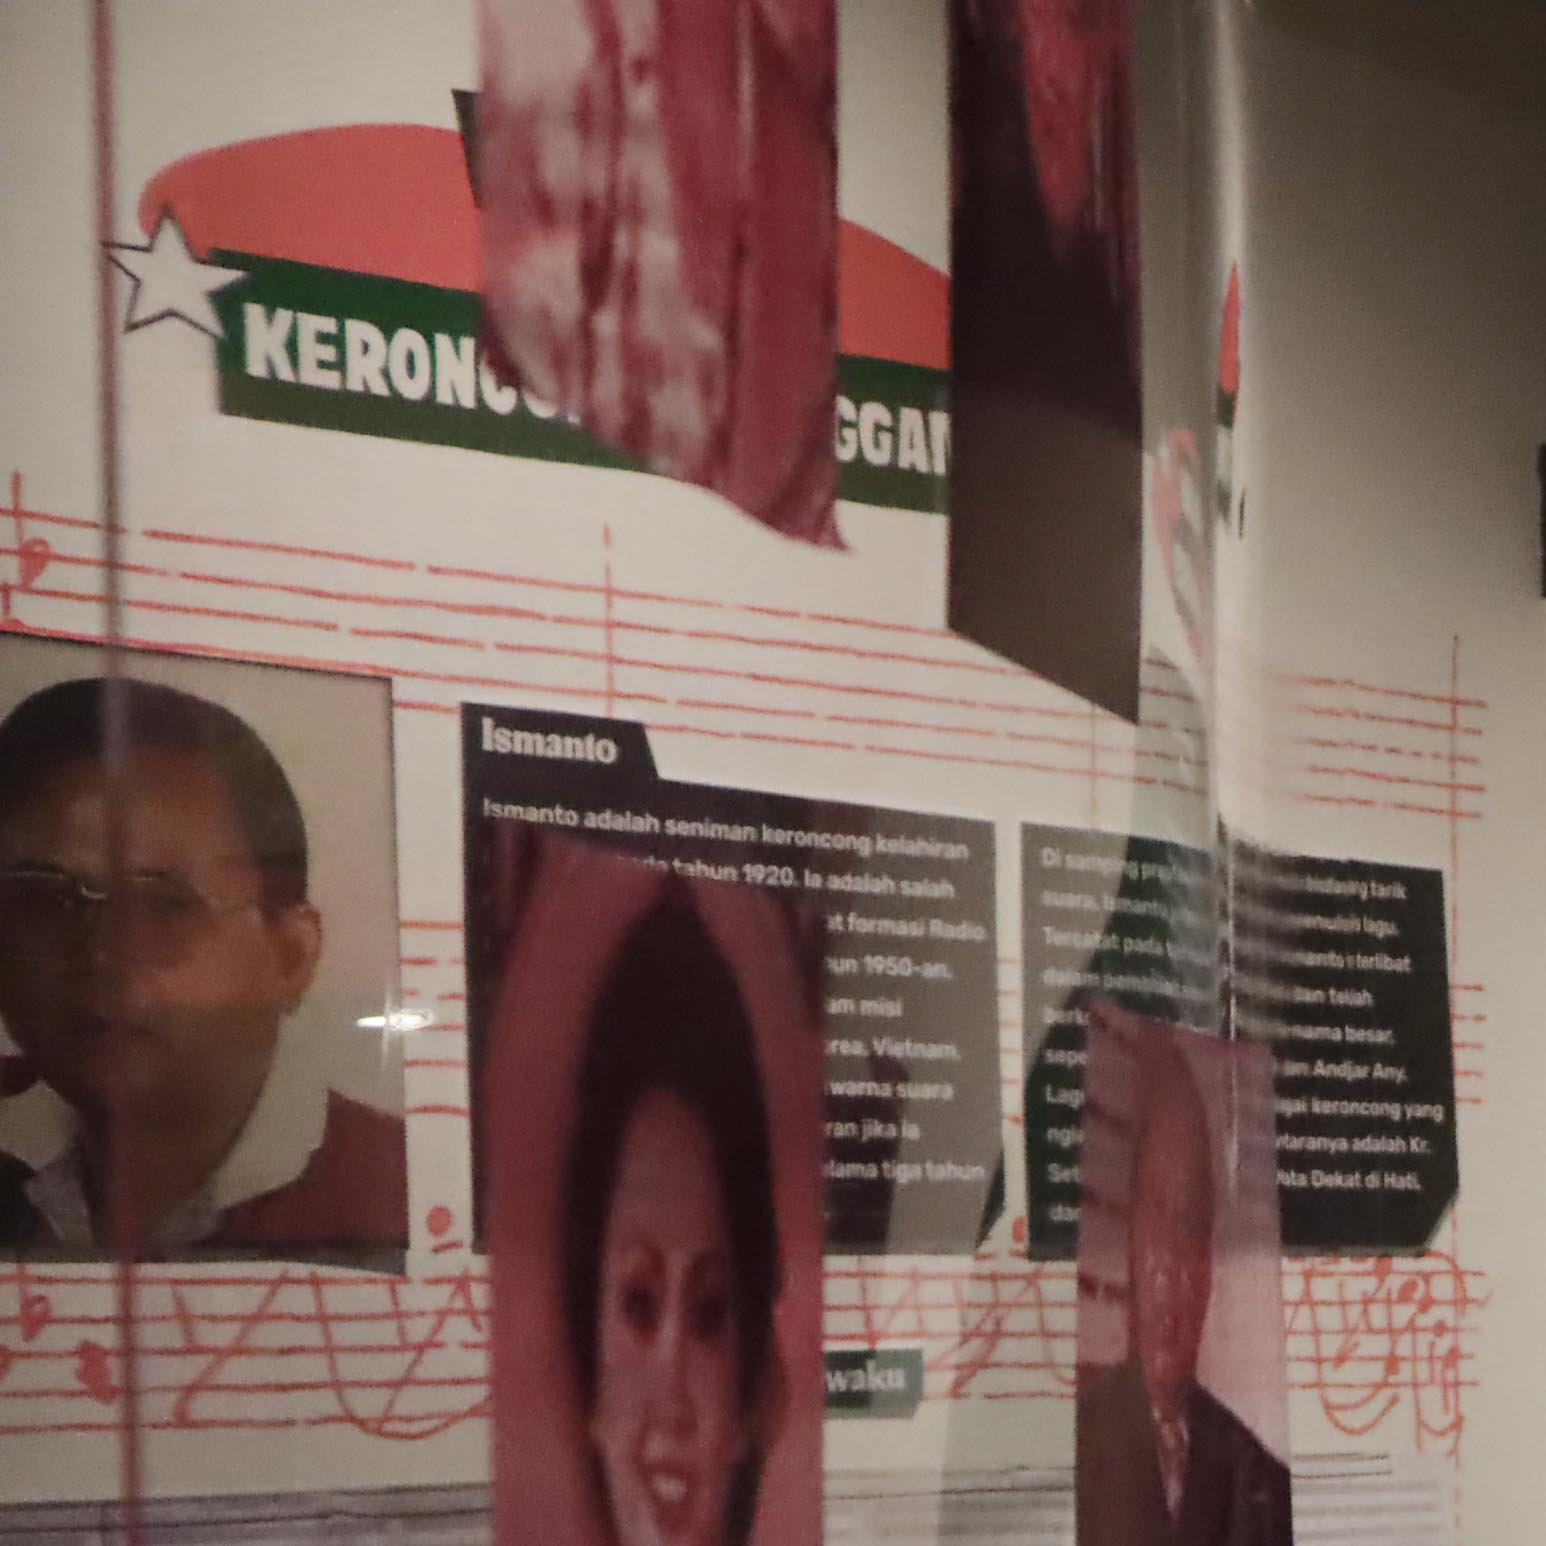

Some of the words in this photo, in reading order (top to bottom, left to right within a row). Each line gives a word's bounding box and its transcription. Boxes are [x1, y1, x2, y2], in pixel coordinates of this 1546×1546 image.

[243, 302, 582, 425] KERONC
[481, 716, 619, 764] Ismanto
[483, 797, 579, 826] Ismanto
[583, 808, 660, 833] adalah
[664, 817, 760, 843] seniman
[761, 823, 872, 858] keroncong
[875, 832, 970, 860] kelahiran
[826, 871, 896, 895] adalah
[899, 876, 956, 899] salah
[847, 911, 926, 938] formasi
[928, 918, 988, 942] Radio
[895, 1082, 955, 1100] suara
[1310, 1096, 1401, 1122] keroncong
[1403, 1102, 1447, 1124] yang
[1351, 1134, 1407, 1153] adalah
[924, 1160, 986, 1181] tahun
[1310, 1168, 1363, 1190] Dekat
[1363, 1170, 1381, 1190] di
